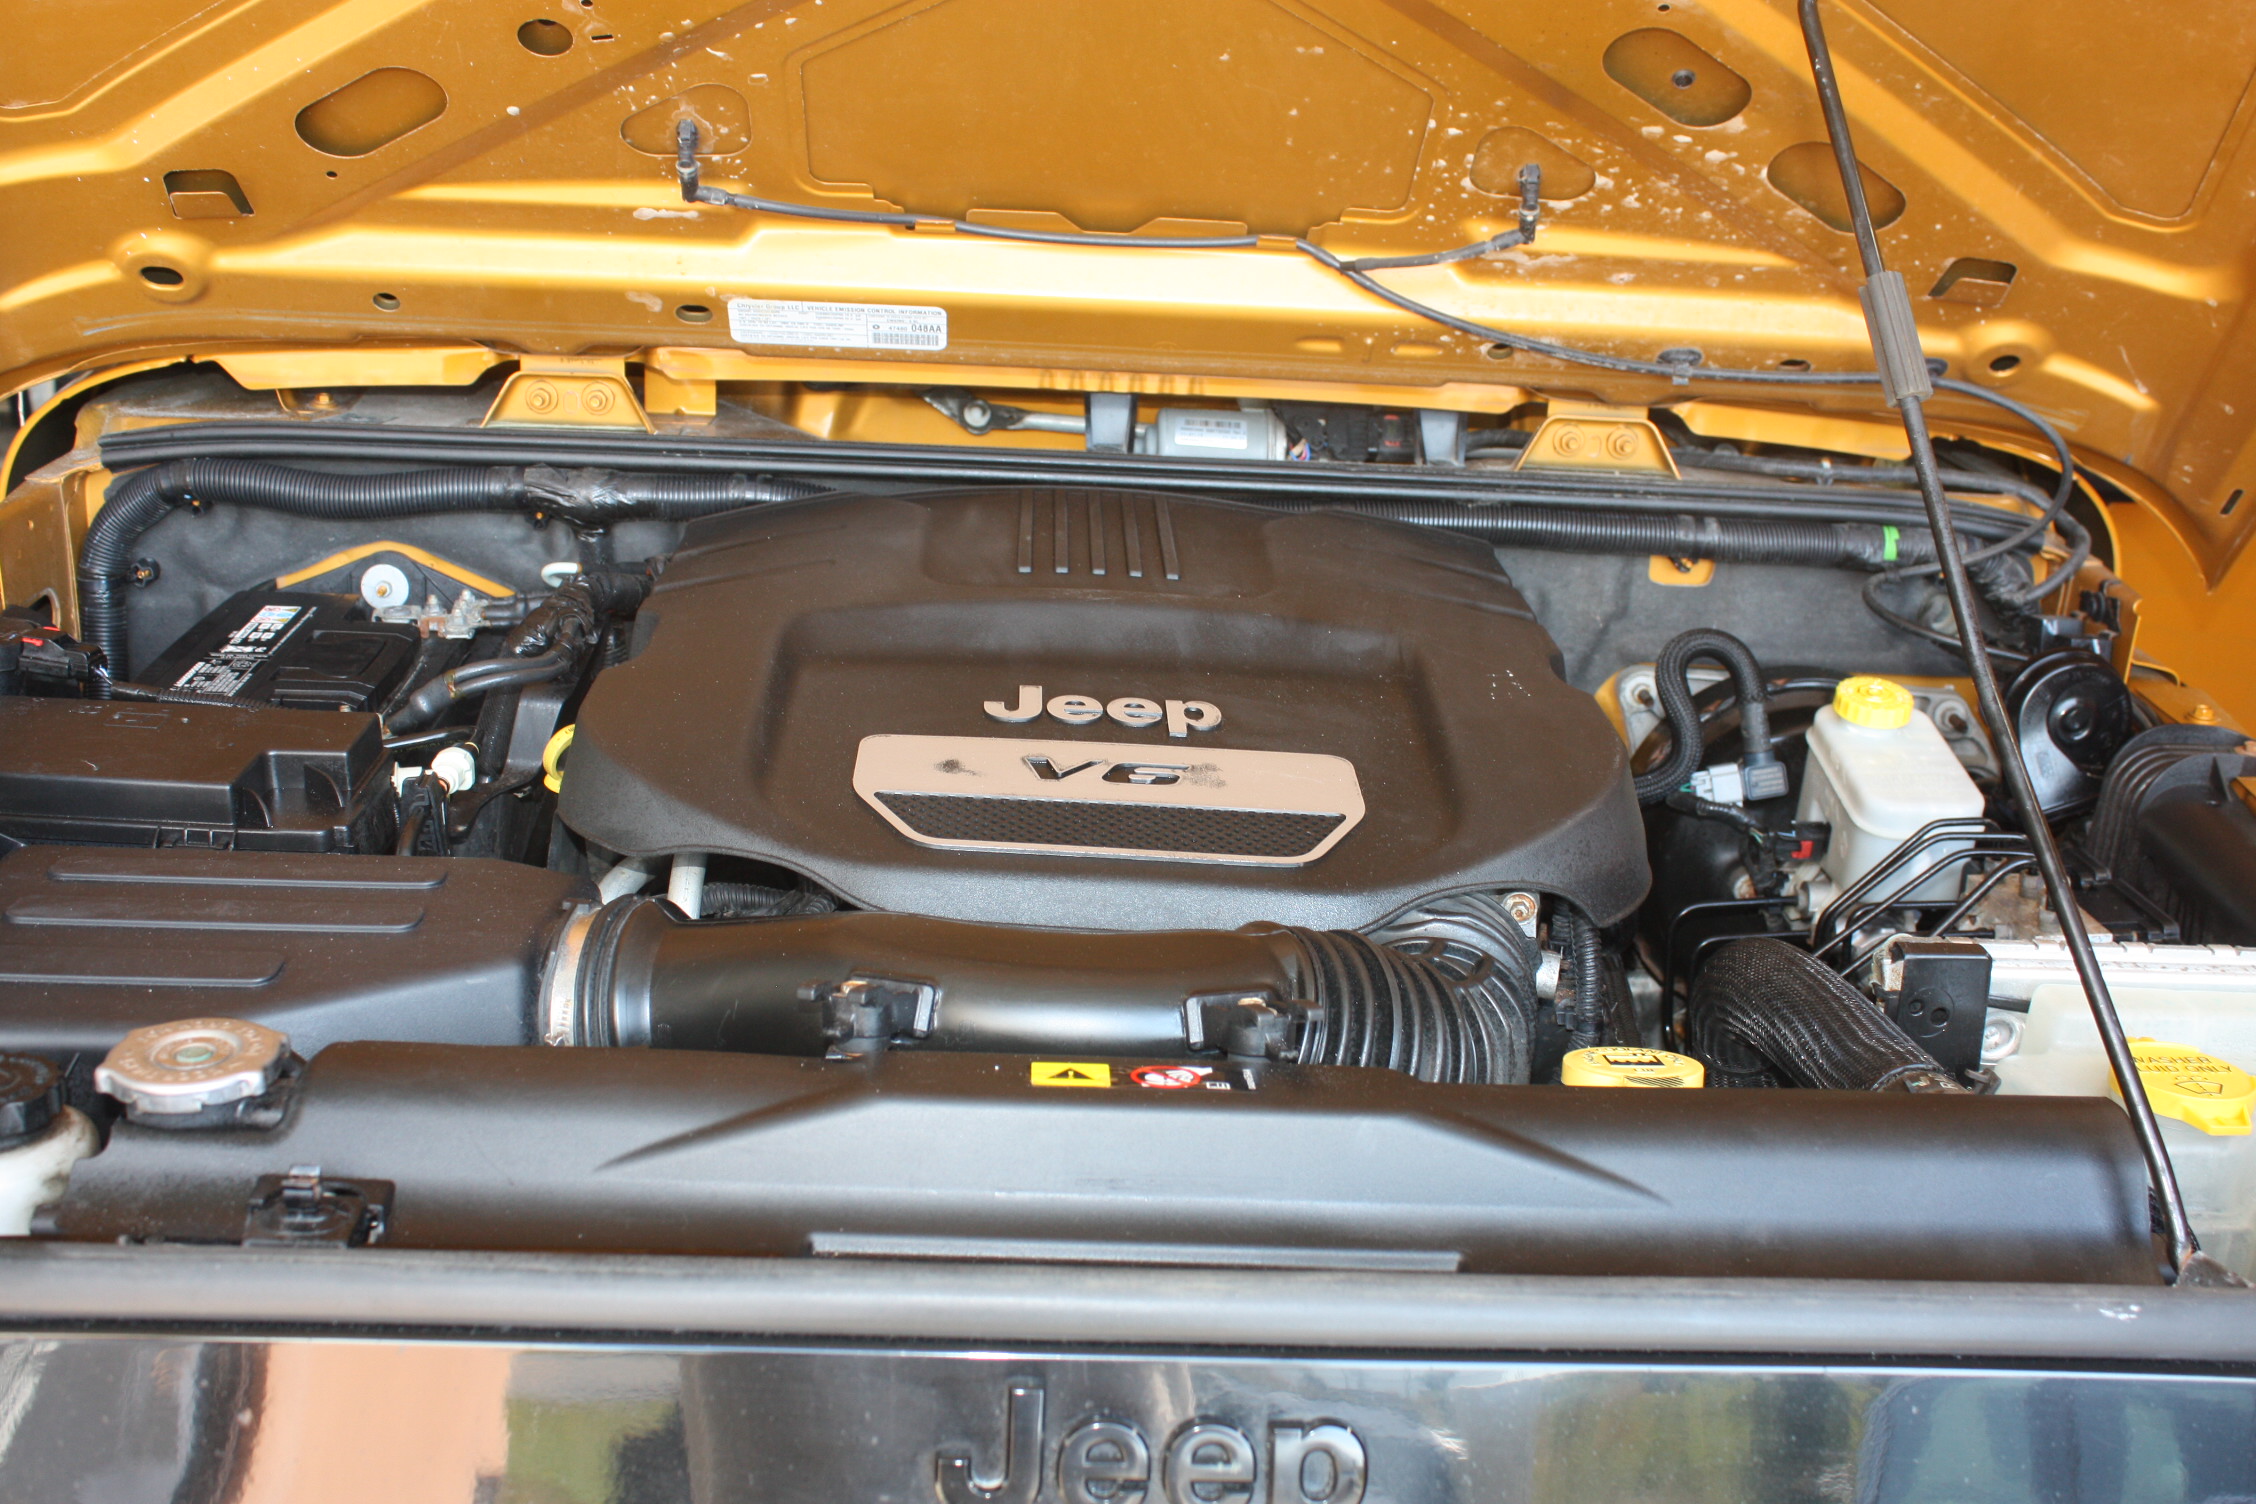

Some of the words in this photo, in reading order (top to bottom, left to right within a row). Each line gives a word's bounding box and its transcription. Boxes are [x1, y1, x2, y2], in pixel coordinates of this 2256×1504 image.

[898, 308, 942, 316] INFORMATION
[911, 324, 942, 332] 048AA
[983, 684, 1222, 738] Jeep
[1021, 755, 1190, 786] V6
[2137, 1065, 2180, 1073] LUID
[2186, 1065, 2232, 1073] ONLY
[935, 1383, 1368, 1504] Jeep
